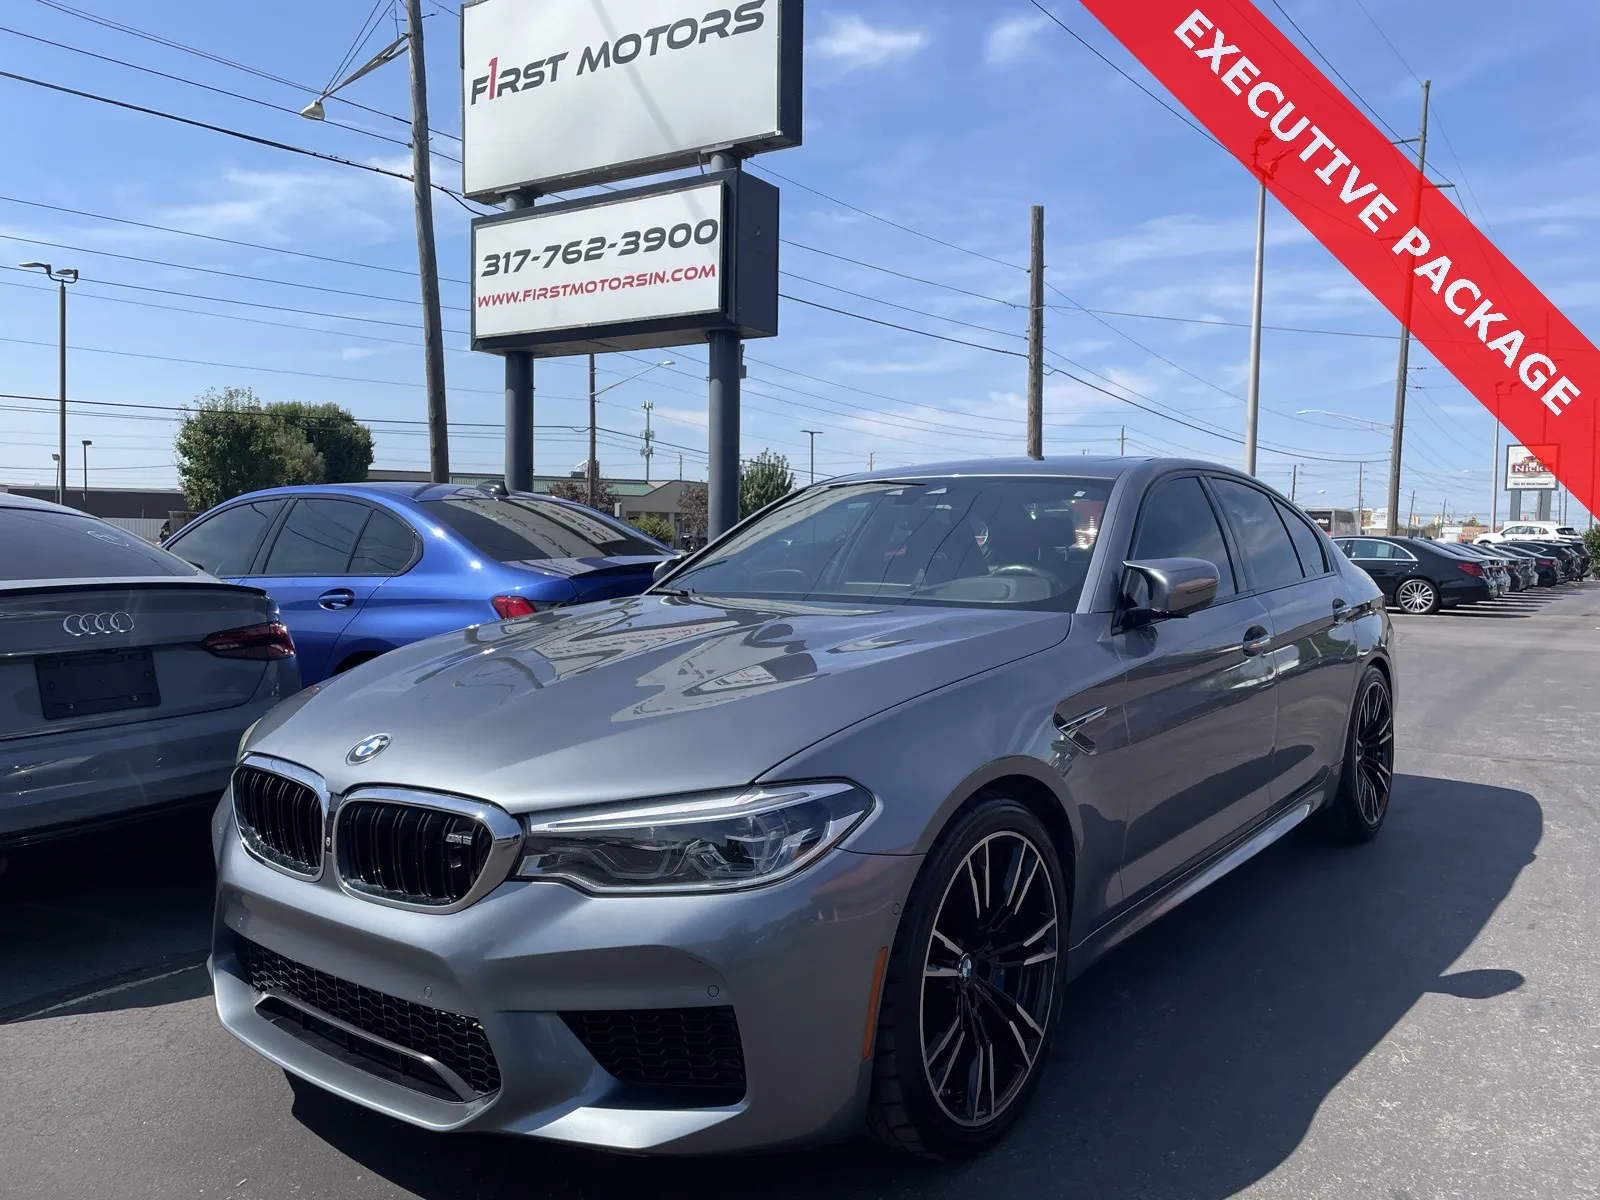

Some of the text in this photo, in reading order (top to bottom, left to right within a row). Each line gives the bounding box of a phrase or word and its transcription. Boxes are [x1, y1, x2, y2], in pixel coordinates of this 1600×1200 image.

[576, 0, 766, 76] MOTORS
[481, 218, 719, 277] 317-762-3900
[478, 264, 716, 308] WWW.FIRSTMOTORSIN.COM
